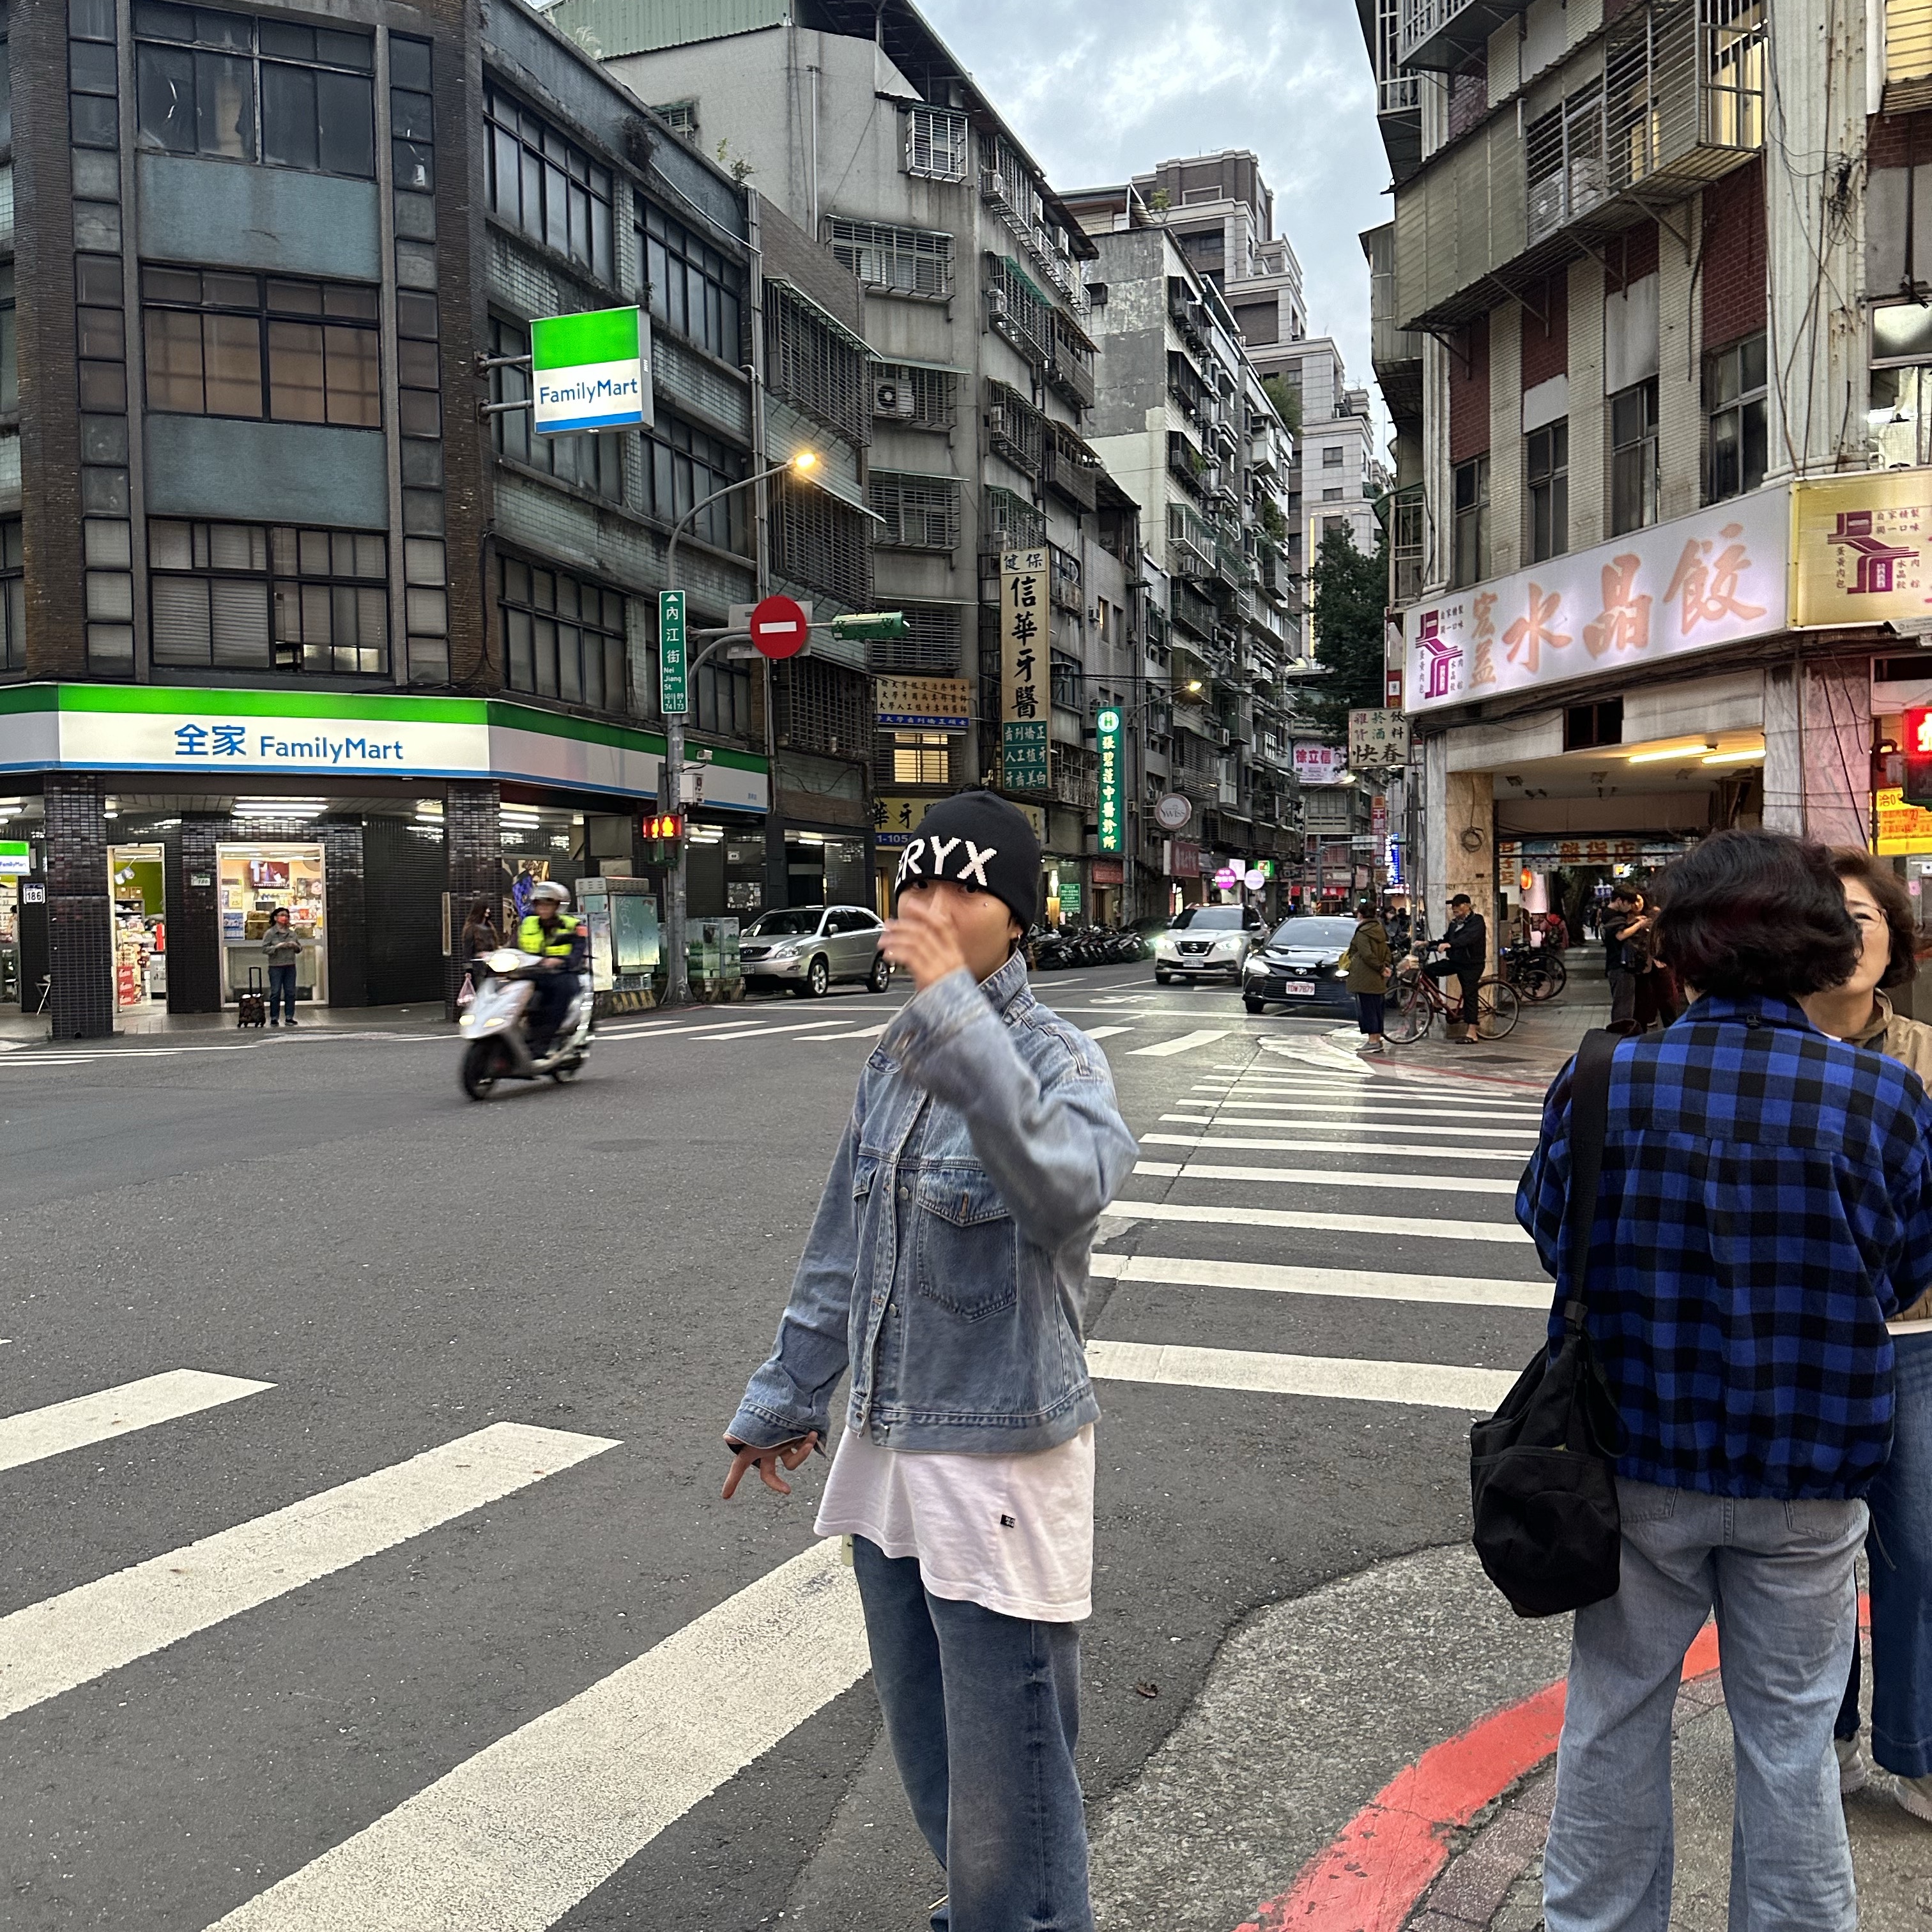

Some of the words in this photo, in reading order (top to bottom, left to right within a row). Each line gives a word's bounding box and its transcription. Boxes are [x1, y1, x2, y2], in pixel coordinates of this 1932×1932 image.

[540, 378, 638, 404] FamilyMart
[1004, 553, 1043, 571] 健保
[1503, 523, 1767, 673] 水晶餃
[1011, 576, 1039, 719] 信華牙醫
[174, 724, 247, 756] 全家
[260, 735, 404, 763] FamilyMart
[1005, 746, 1046, 763] 人工植牙
[1006, 770, 1046, 787] 牙齒美白
[27, 891, 42, 901] 186
